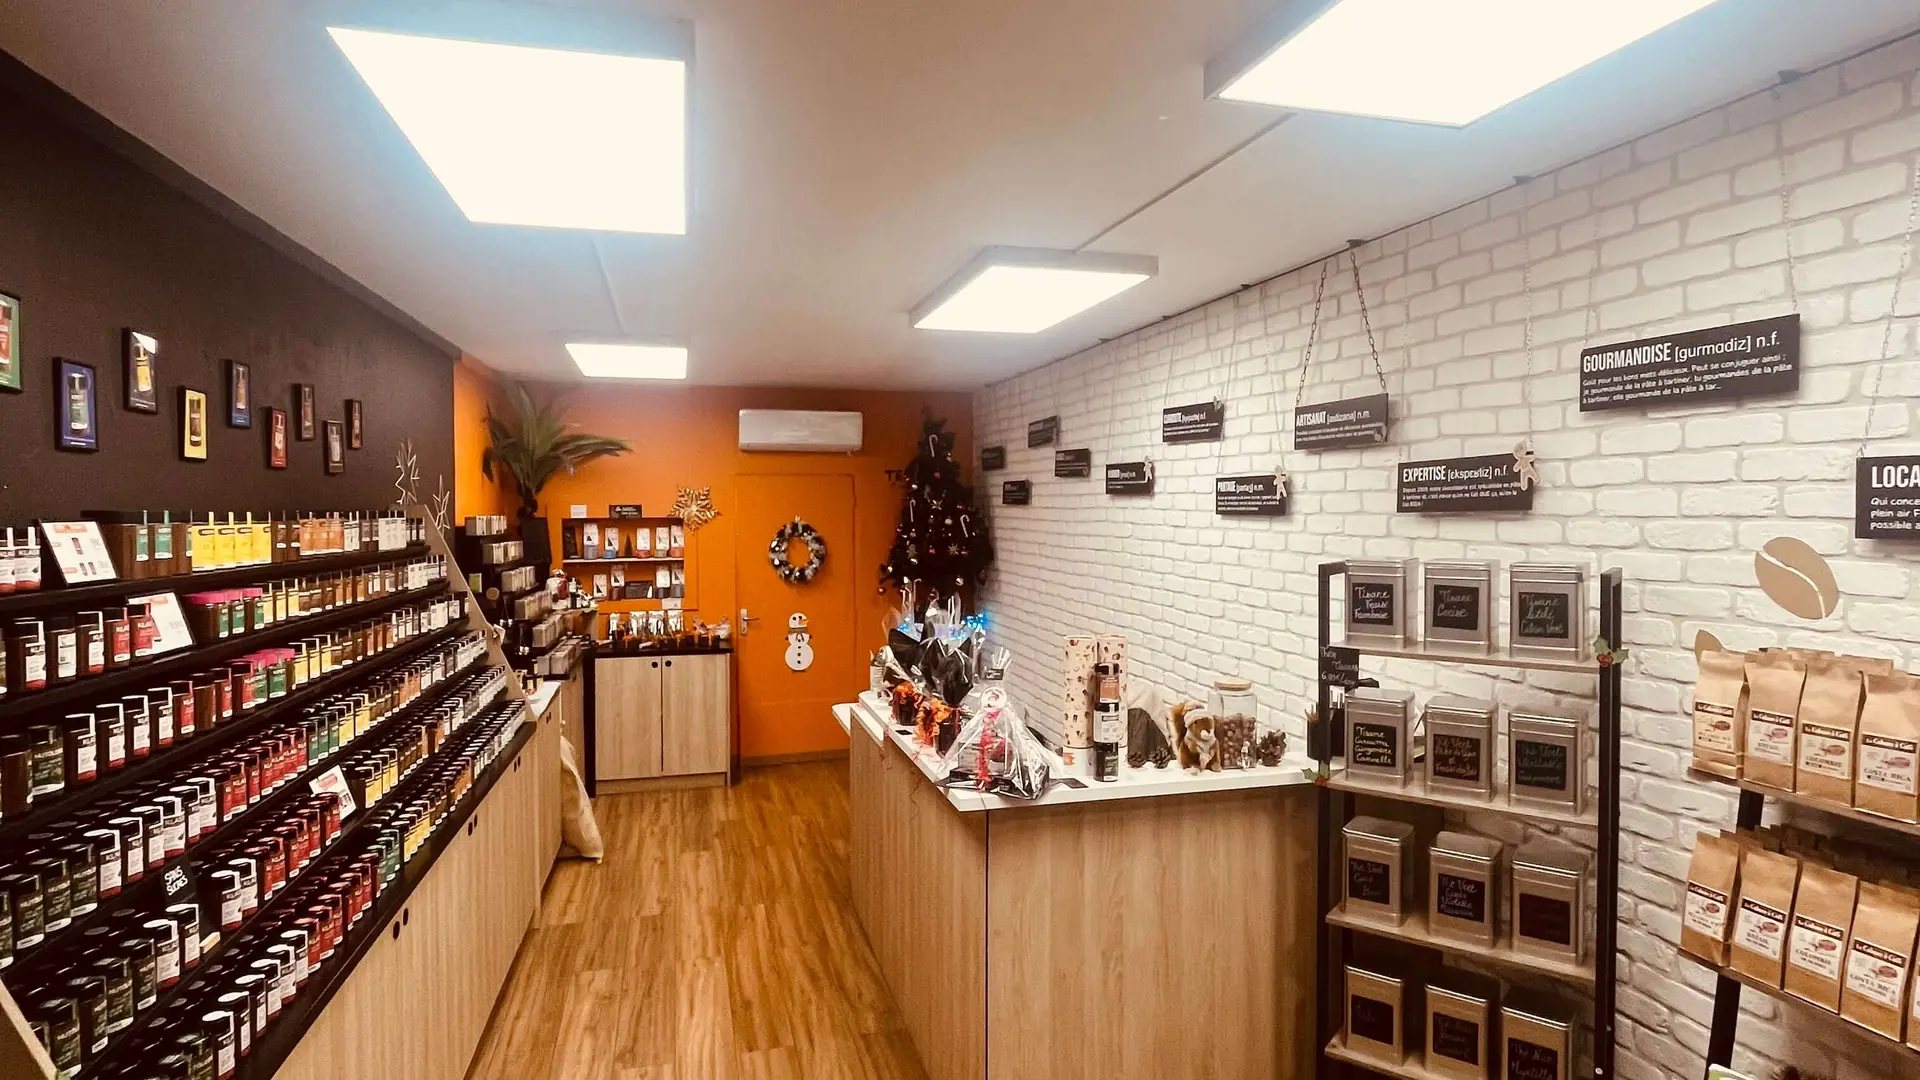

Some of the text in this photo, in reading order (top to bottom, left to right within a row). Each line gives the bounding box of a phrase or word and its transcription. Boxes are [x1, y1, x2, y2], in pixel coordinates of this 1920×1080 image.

[1583, 330, 1780, 373] GOURMANDISE [gurmadiz] n.f.
[1691, 363, 1709, 373] Peut
[1710, 362, 1720, 370] se
[1721, 357, 1760, 369] conjuguer
[1703, 369, 1750, 382] gourmandes
[1751, 367, 1762, 375] de
[1763, 365, 1772, 374] la
[1773, 363, 1793, 373] pâte
[1403, 465, 1447, 482] EXPERTISE
[1870, 497, 1888, 506] Qui
[1870, 521, 1912, 531] possible
[1355, 725, 1385, 738] Tisane
[1356, 752, 1392, 764] Cannelle
